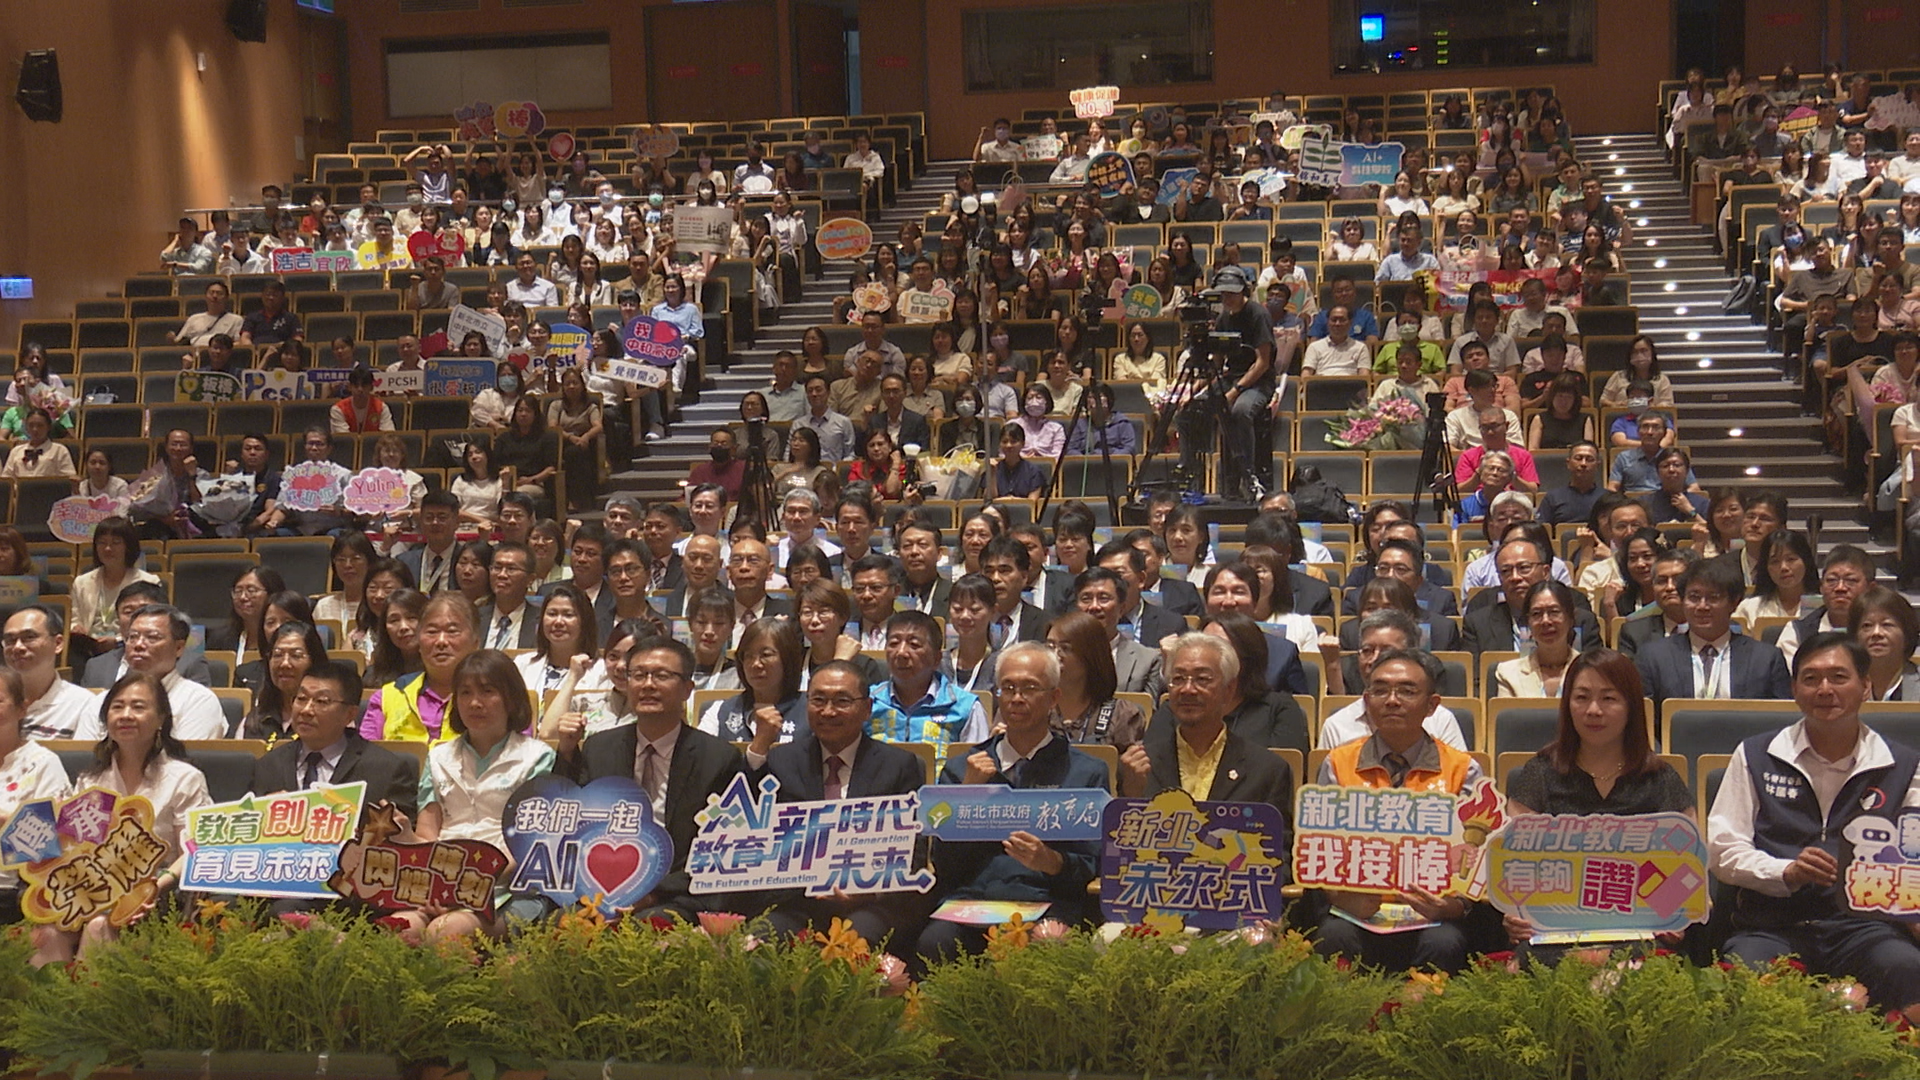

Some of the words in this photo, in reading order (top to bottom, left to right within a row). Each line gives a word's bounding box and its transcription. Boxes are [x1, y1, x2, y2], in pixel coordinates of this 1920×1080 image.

[634, 322, 651, 339] 我
[388, 376, 418, 387] PCSH
[355, 480, 396, 495] Yulin
[195, 798, 347, 845] 教育創新
[516, 799, 642, 835] 我們一起
[957, 804, 1031, 819] 新北市政府
[1035, 794, 1101, 832] 教育局
[1301, 790, 1452, 834] 新北教育
[850, 834, 909, 846] Generation
[1115, 811, 1199, 850] 新北
[1508, 816, 1657, 851] 新北教育
[47, 816, 167, 926] 榮耀
[190, 851, 332, 882] 育見未來
[362, 843, 494, 910] 閃耀時刻
[510, 840, 581, 893] AI
[695, 881, 713, 889] The
[715, 878, 750, 888] Future
[752, 877, 764, 886] of
[766, 874, 818, 885] Education
[1113, 864, 1273, 912] 未來式
